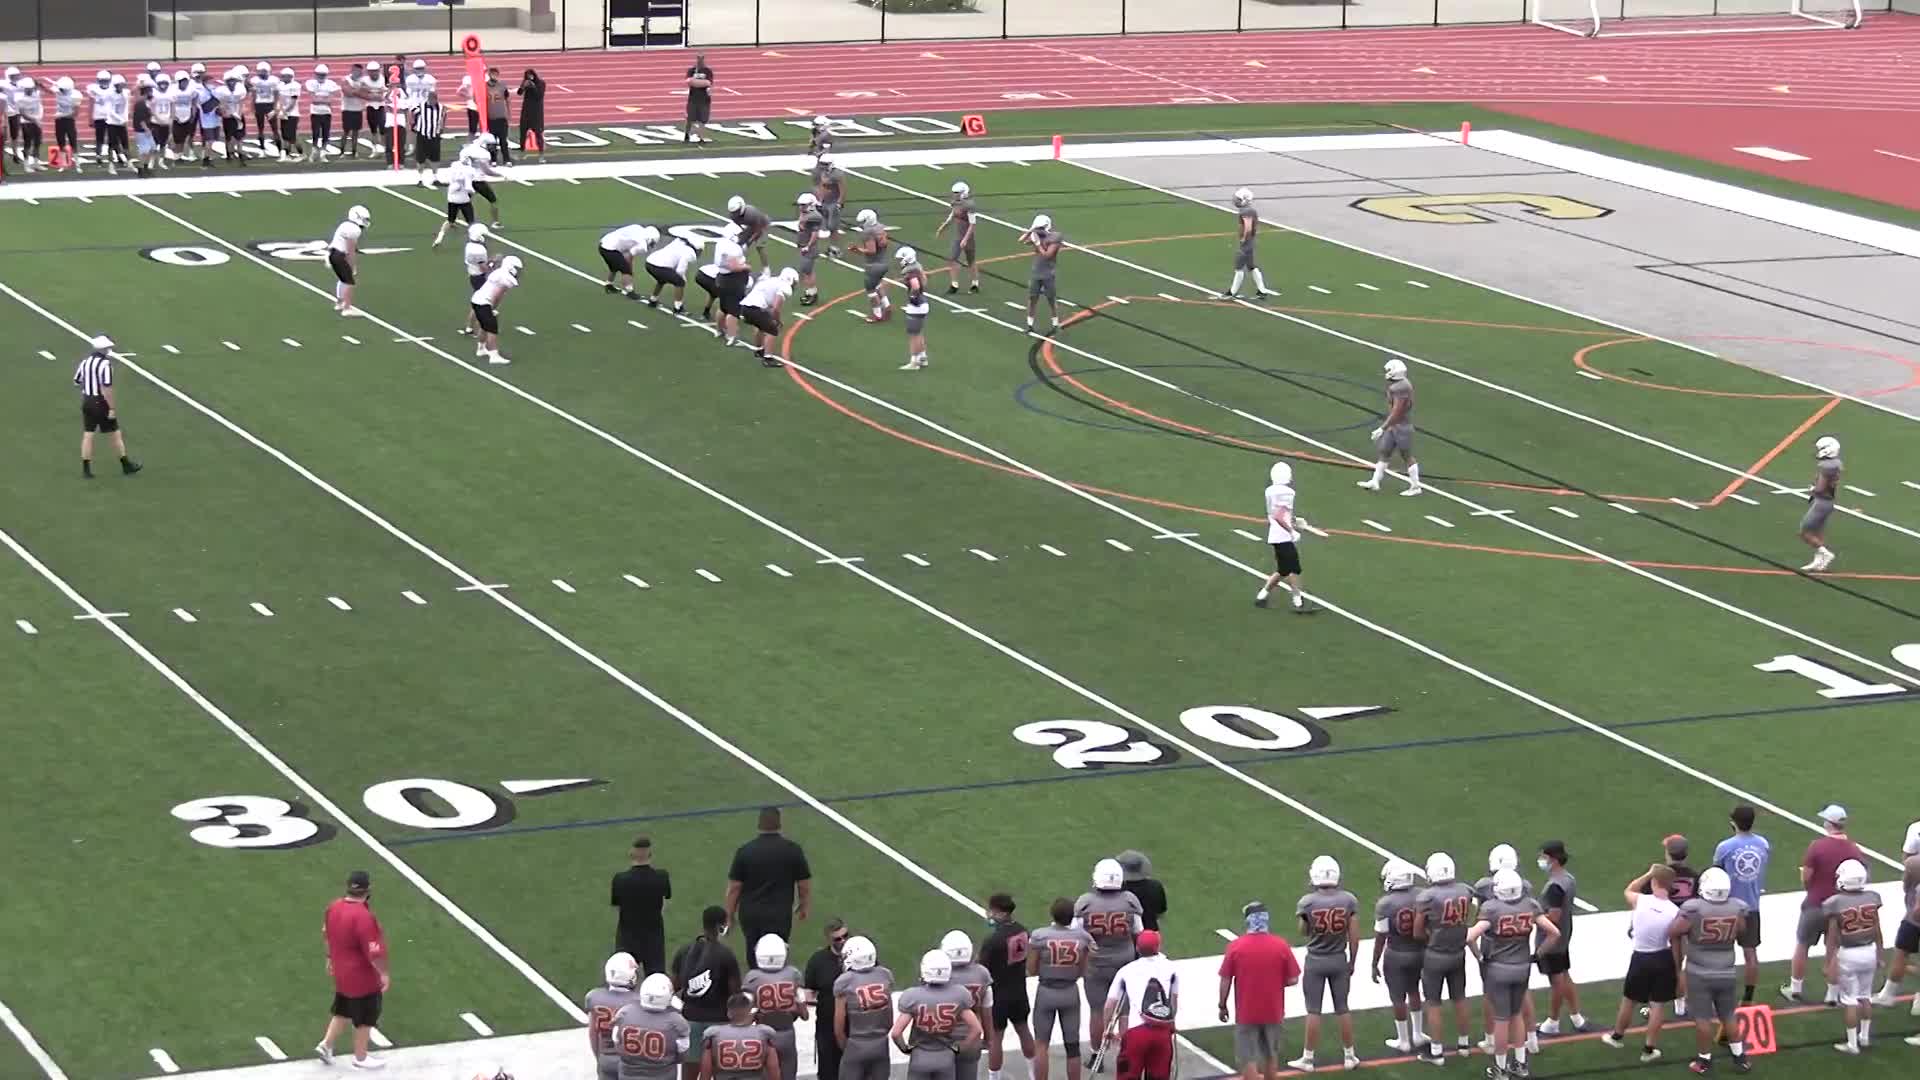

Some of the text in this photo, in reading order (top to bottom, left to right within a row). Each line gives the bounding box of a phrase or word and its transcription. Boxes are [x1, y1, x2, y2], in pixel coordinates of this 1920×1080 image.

[969, 117, 983, 133] G
[1752, 643, 1920, 700] 1
[1013, 705, 1313, 769] 20
[171, 778, 498, 849] 30
[1311, 908, 1346, 936] 36
[1700, 915, 1737, 944] 57
[1047, 939, 1081, 968] 13
[756, 981, 796, 1013] 85
[856, 983, 889, 1012] 15
[916, 1003, 957, 1034] 45
[1736, 1010, 1769, 1049] 20
[622, 1025, 667, 1061] 60
[718, 1039, 763, 1070] 62
